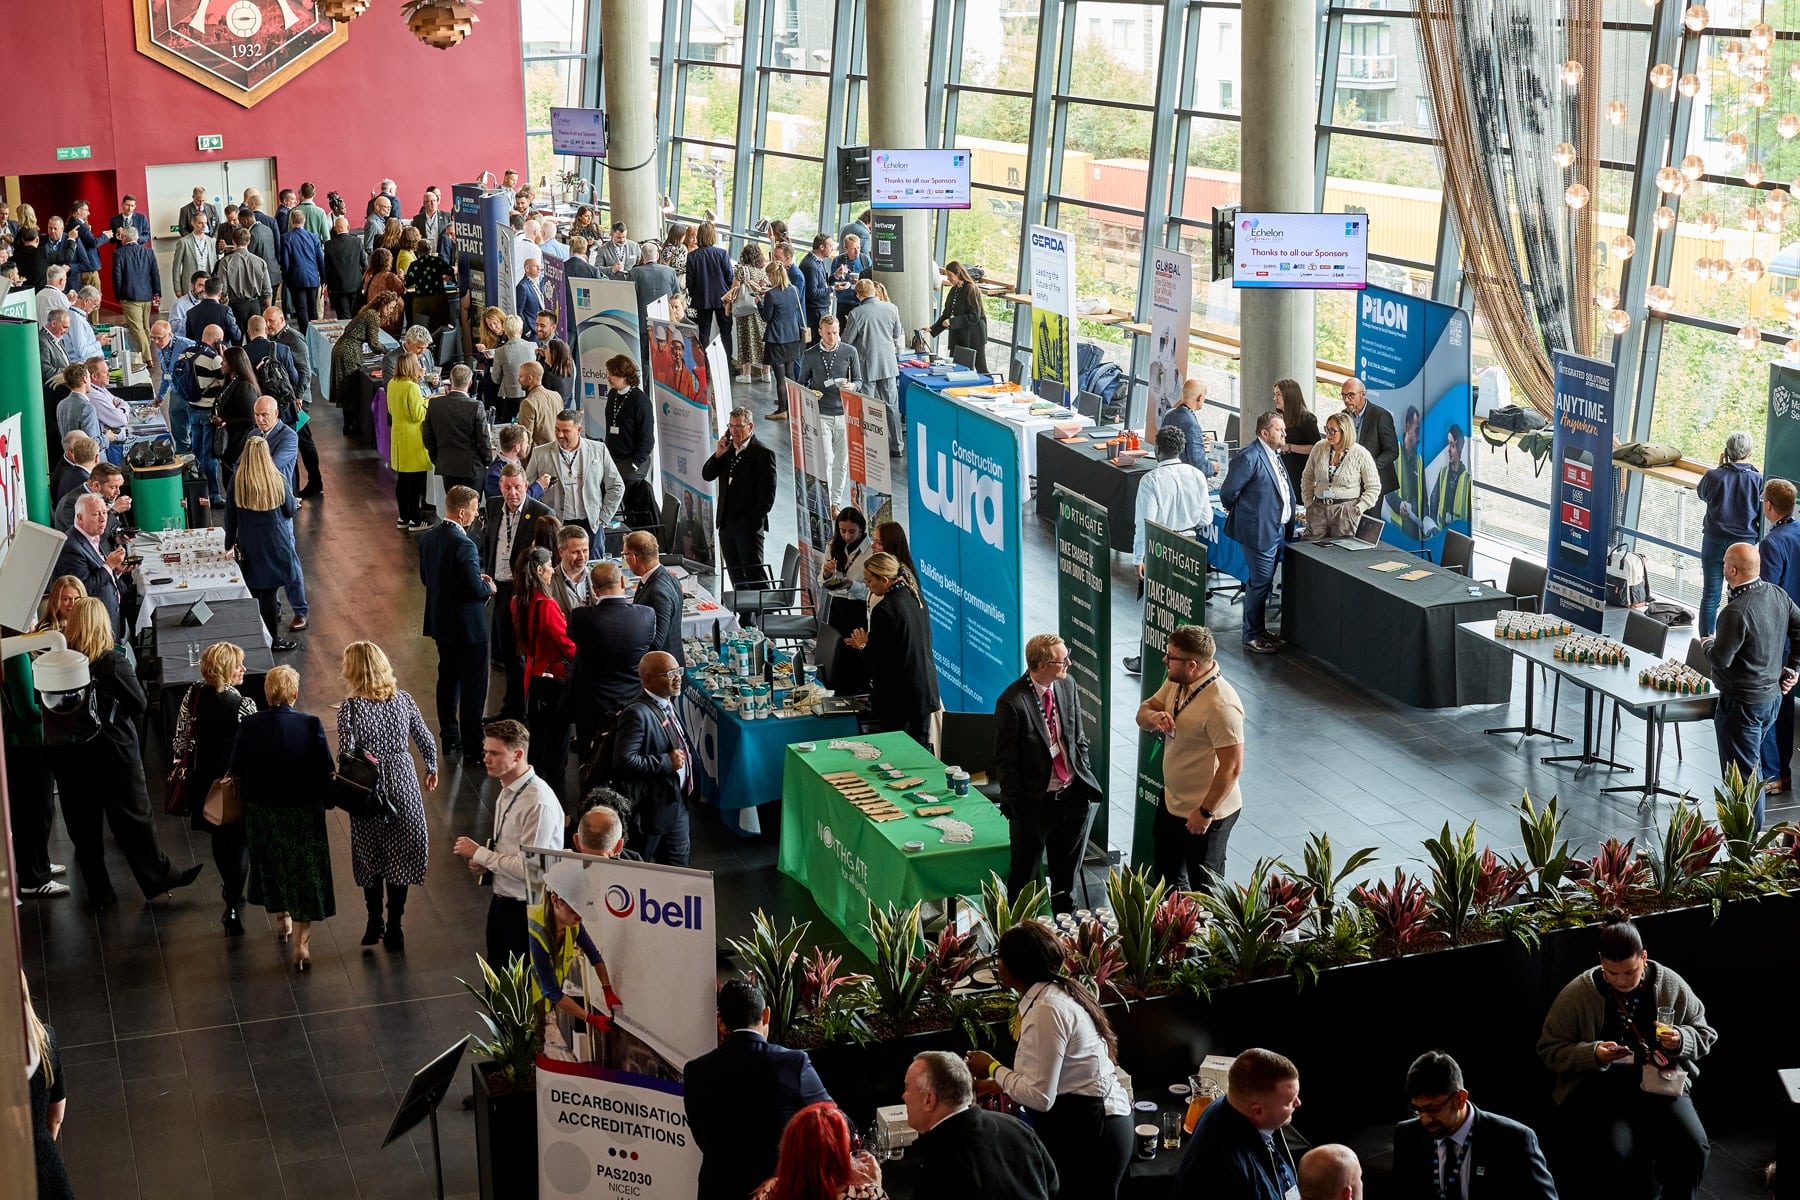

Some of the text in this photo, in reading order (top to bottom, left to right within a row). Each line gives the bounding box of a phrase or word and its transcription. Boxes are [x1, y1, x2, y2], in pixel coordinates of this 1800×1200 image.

[231, 43, 263, 58] 1932
[883, 161, 908, 169] Echelon
[930, 177, 956, 186] Sponsors
[1031, 233, 1065, 254] GERDA
[1251, 227, 1284, 237] Echelon
[457, 238, 479, 256] THAT
[1251, 248, 1349, 259] Thanks to all our Sponsors
[1155, 259, 1181, 276] GLOBAL
[582, 367, 608, 379] Echelo
[1585, 372, 1610, 386] SOLUTIONS
[1556, 392, 1607, 424] ANYTIME.
[951, 439, 1003, 480] Construction
[916, 421, 1004, 552] Lura
[1059, 501, 1103, 537] NORTHGATE
[1059, 538, 1072, 557] TAKE
[1071, 543, 1089, 567] CHARGE
[1148, 538, 1200, 577] NORTHGATE
[1072, 562, 1085, 584] DRIVE
[1090, 574, 1103, 593] ZERO
[920, 558, 943, 589] Building
[944, 574, 963, 598] better
[963, 590, 1006, 625] communities
[1147, 578, 1165, 605] TAKE
[1165, 586, 1192, 619] CHARGE
[1146, 602, 1175, 633] OF YOUR
[1145, 625, 1166, 651] DRIVE
[639, 887, 702, 930] bell
[551, 1088, 688, 1128] DECARBONISATION
[558, 1110, 686, 1147] ACCREDITATIONS
[596, 1163, 652, 1187] PAS2030
[608, 1181, 641, 1197] NICEIC
